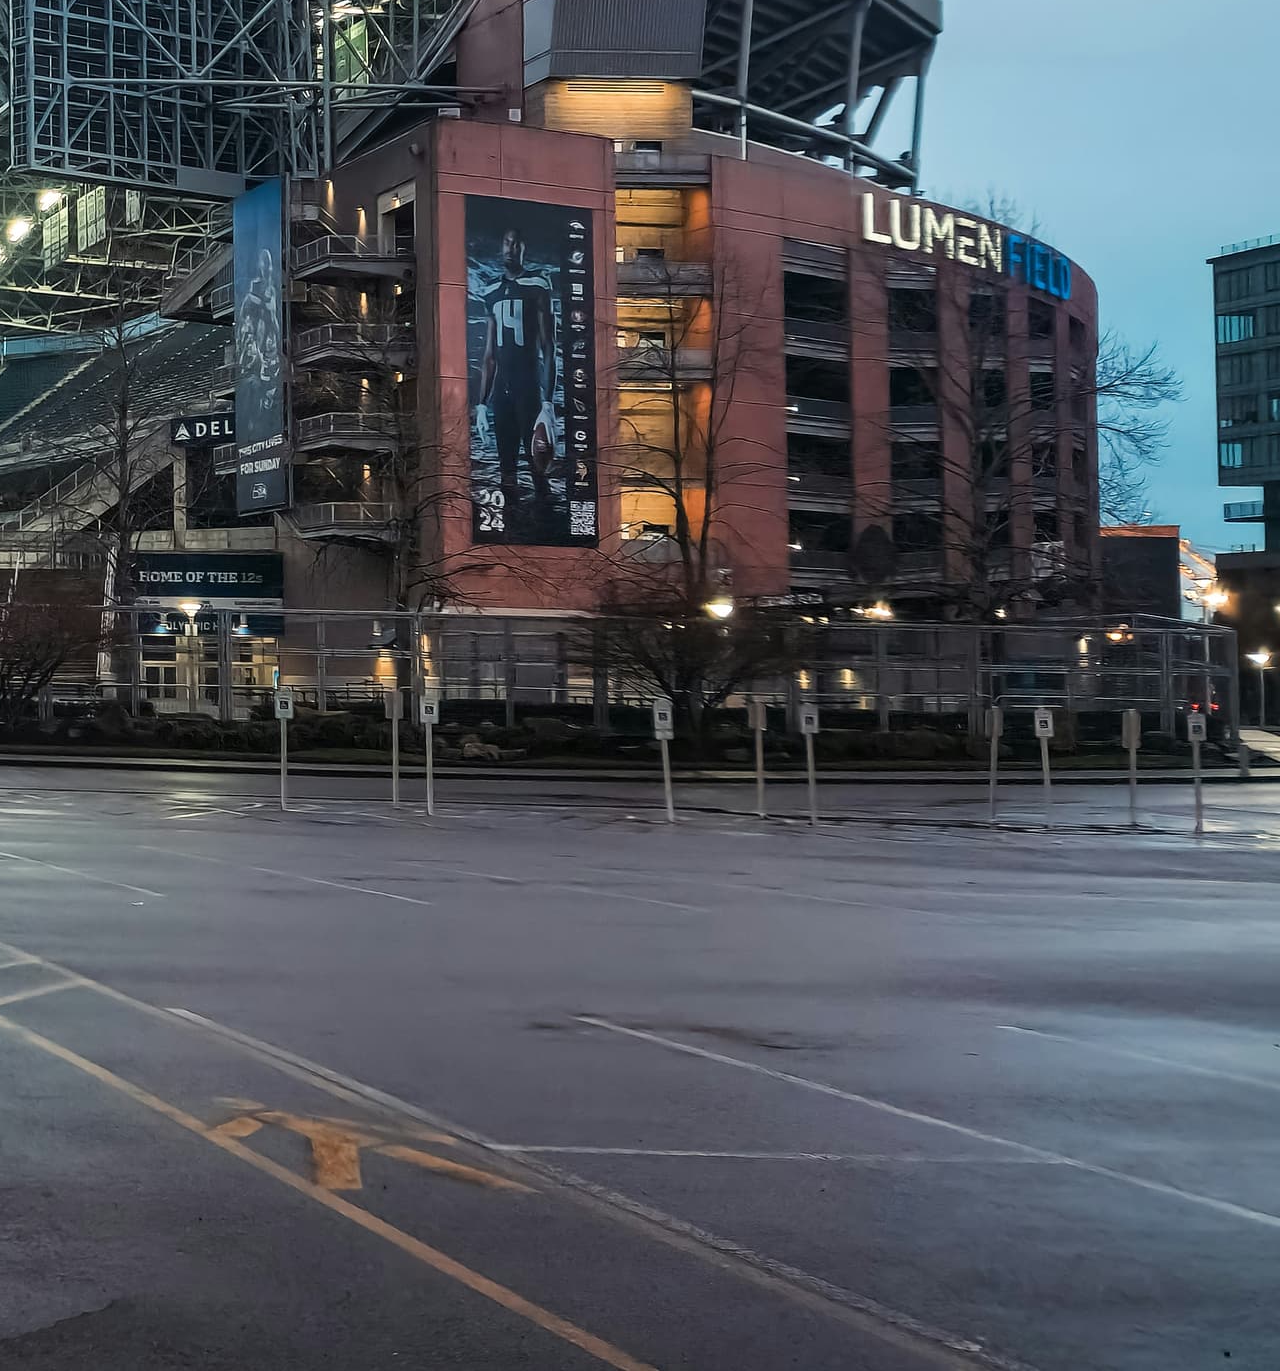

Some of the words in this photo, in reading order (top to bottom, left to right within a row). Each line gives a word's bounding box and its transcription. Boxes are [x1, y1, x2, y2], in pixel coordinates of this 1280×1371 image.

[862, 192, 1002, 273] LUMEN
[1006, 233, 1072, 301] FIELD
[493, 299, 524, 346] 14
[240, 461, 254, 476] FOR
[139, 571, 183, 583] HOME
[185, 571, 205, 583] OF
[207, 571, 238, 583] THE
